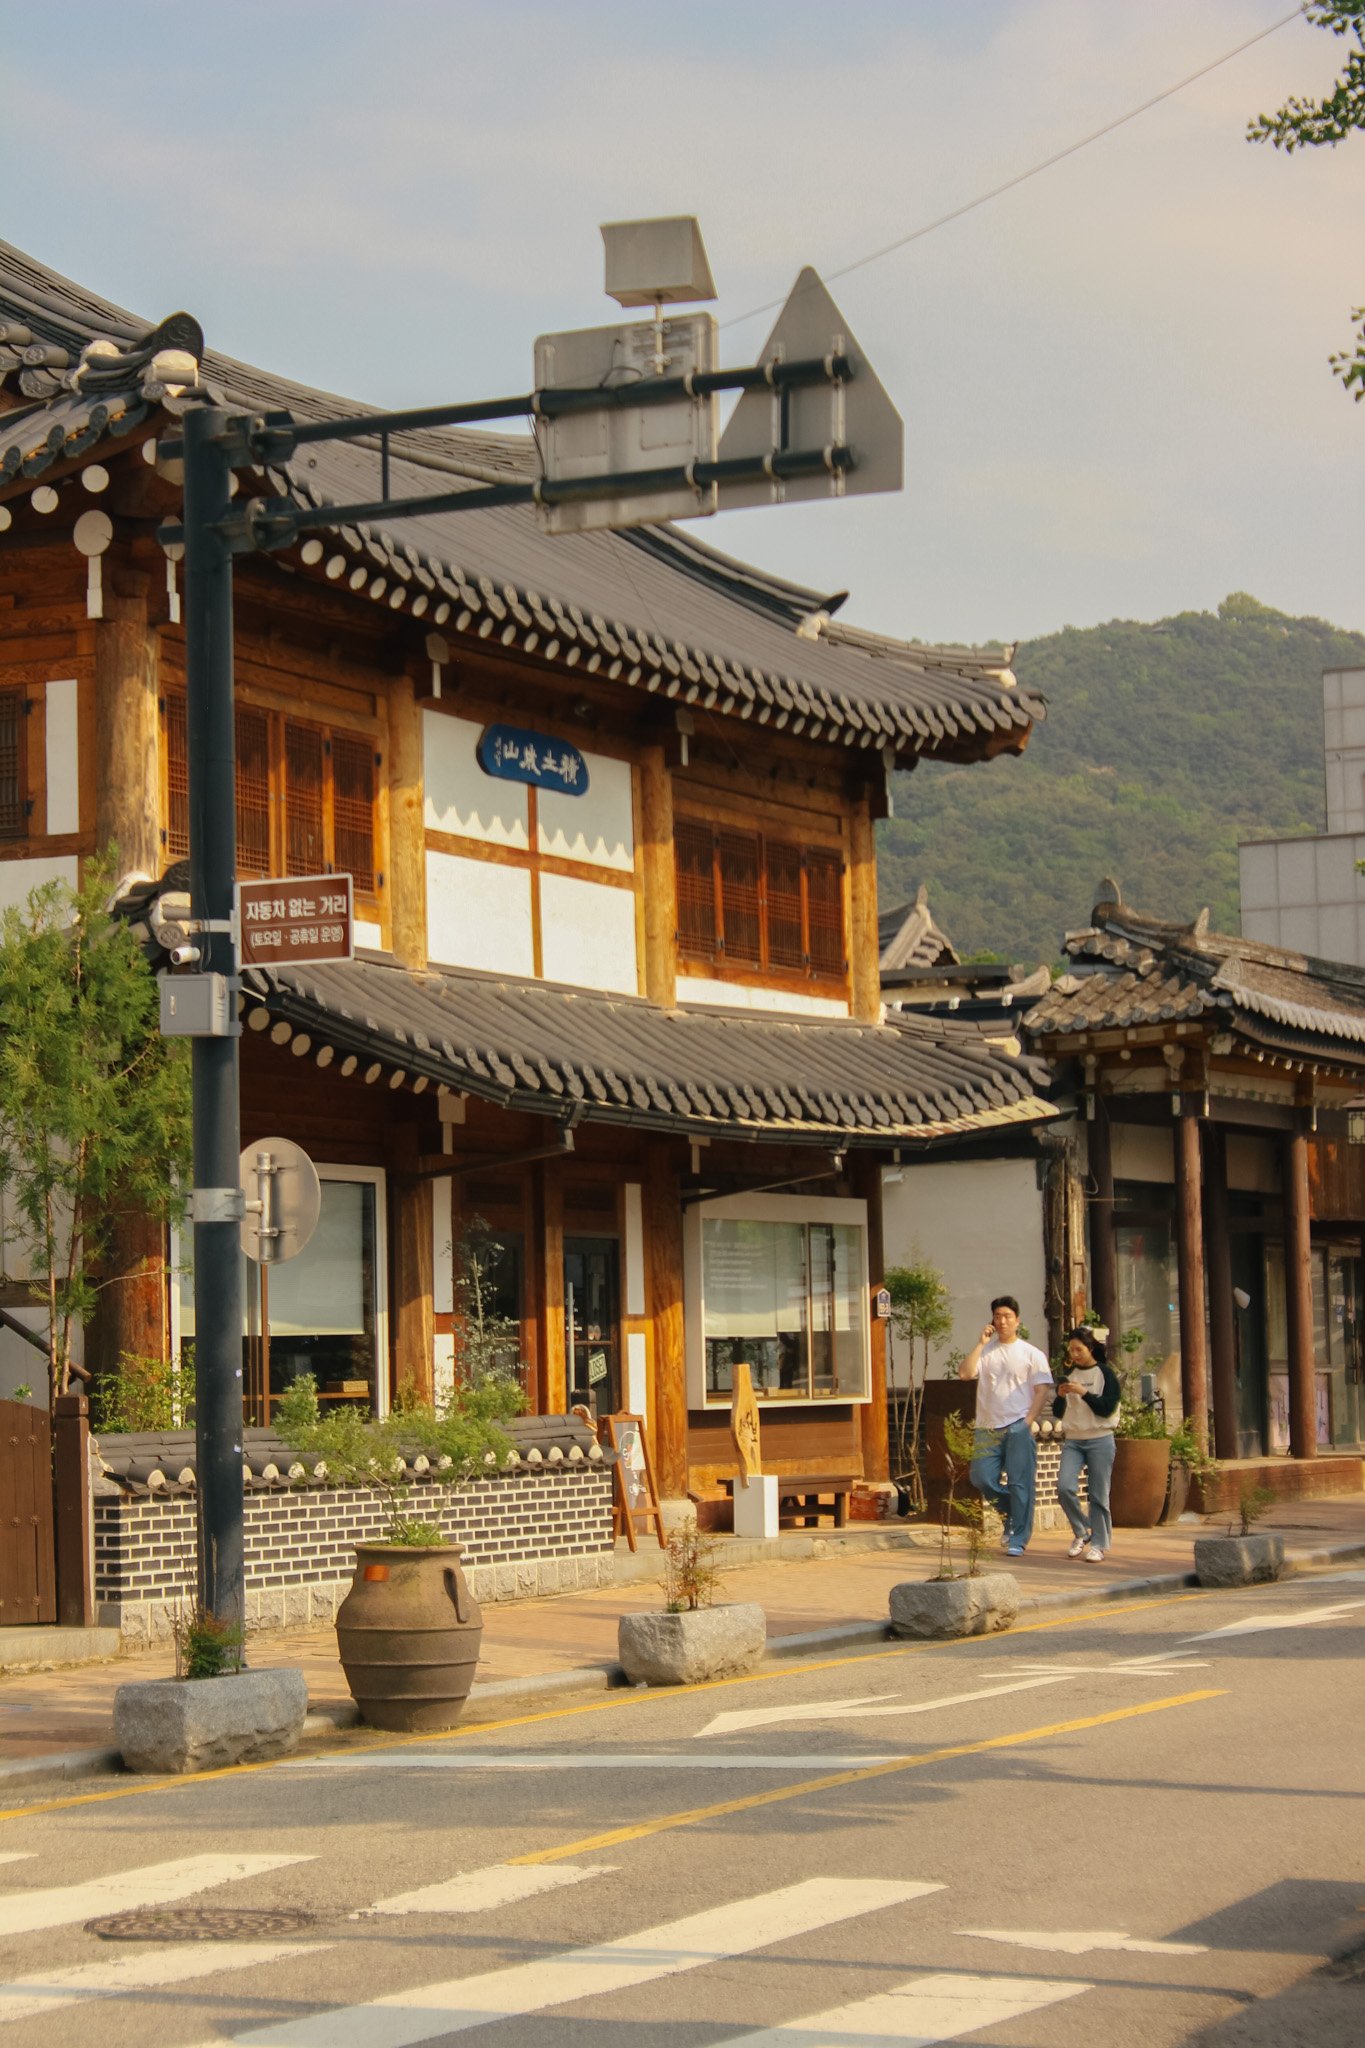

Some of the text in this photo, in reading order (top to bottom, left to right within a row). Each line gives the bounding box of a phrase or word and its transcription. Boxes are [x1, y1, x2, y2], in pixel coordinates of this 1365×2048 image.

[245, 894, 347, 921] 자동차 없는 거리
[250, 930, 282, 949] (토요일
[289, 927, 319, 946] 공휴일
[320, 924, 344, 944] 운영)
